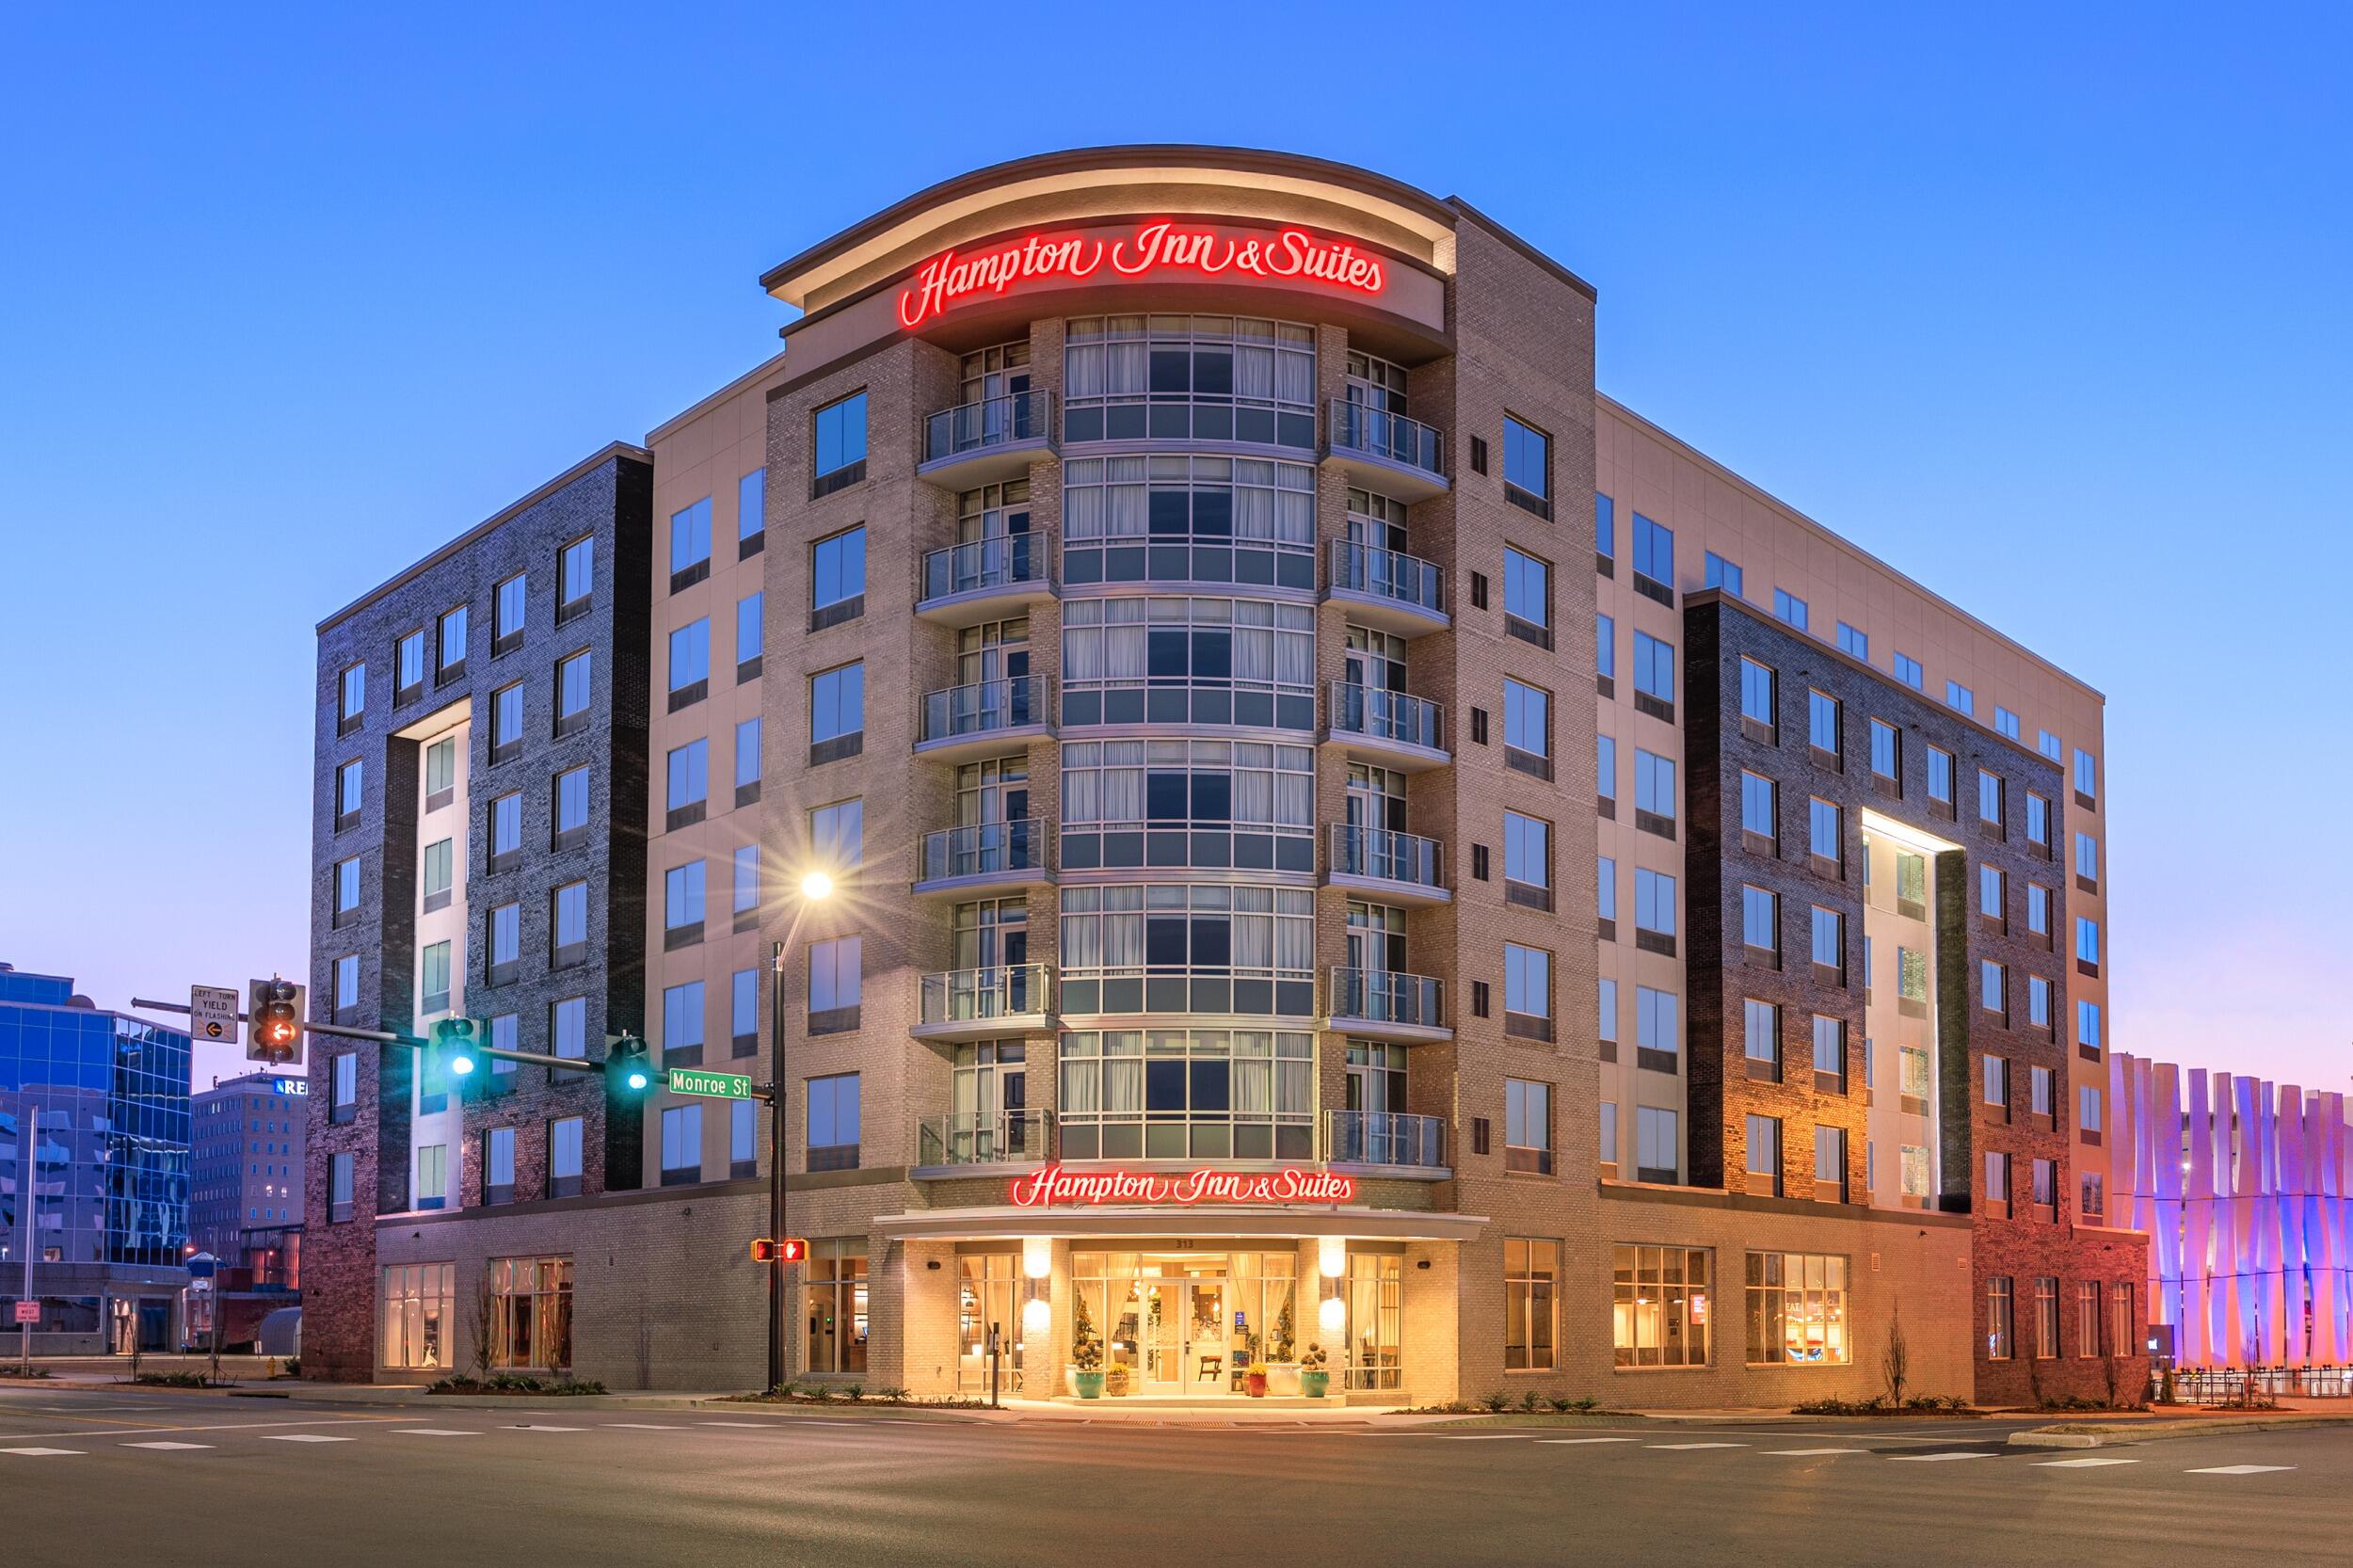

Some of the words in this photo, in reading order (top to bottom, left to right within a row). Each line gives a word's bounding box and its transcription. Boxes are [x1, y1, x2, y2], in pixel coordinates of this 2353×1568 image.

[901, 236, 1103, 327] Hampton
[1112, 223, 1235, 274] Inn
[1236, 240, 1268, 276] &
[1265, 231, 1383, 292] Suites
[194, 989, 212, 998] LEFT
[218, 992, 236, 1000] TURN
[202, 1000, 228, 1011] YIELD
[204, 1012, 235, 1022] FLASHING
[284, 1080, 309, 1096] RE
[673, 1072, 727, 1094] Monroe
[733, 1079, 748, 1096] St
[1013, 1166, 1169, 1207] Hampton
[1173, 1169, 1254, 1202] Inn
[1254, 1176, 1276, 1200] &
[1273, 1169, 1352, 1199] Suites
[1176, 1239, 1194, 1249] 313
